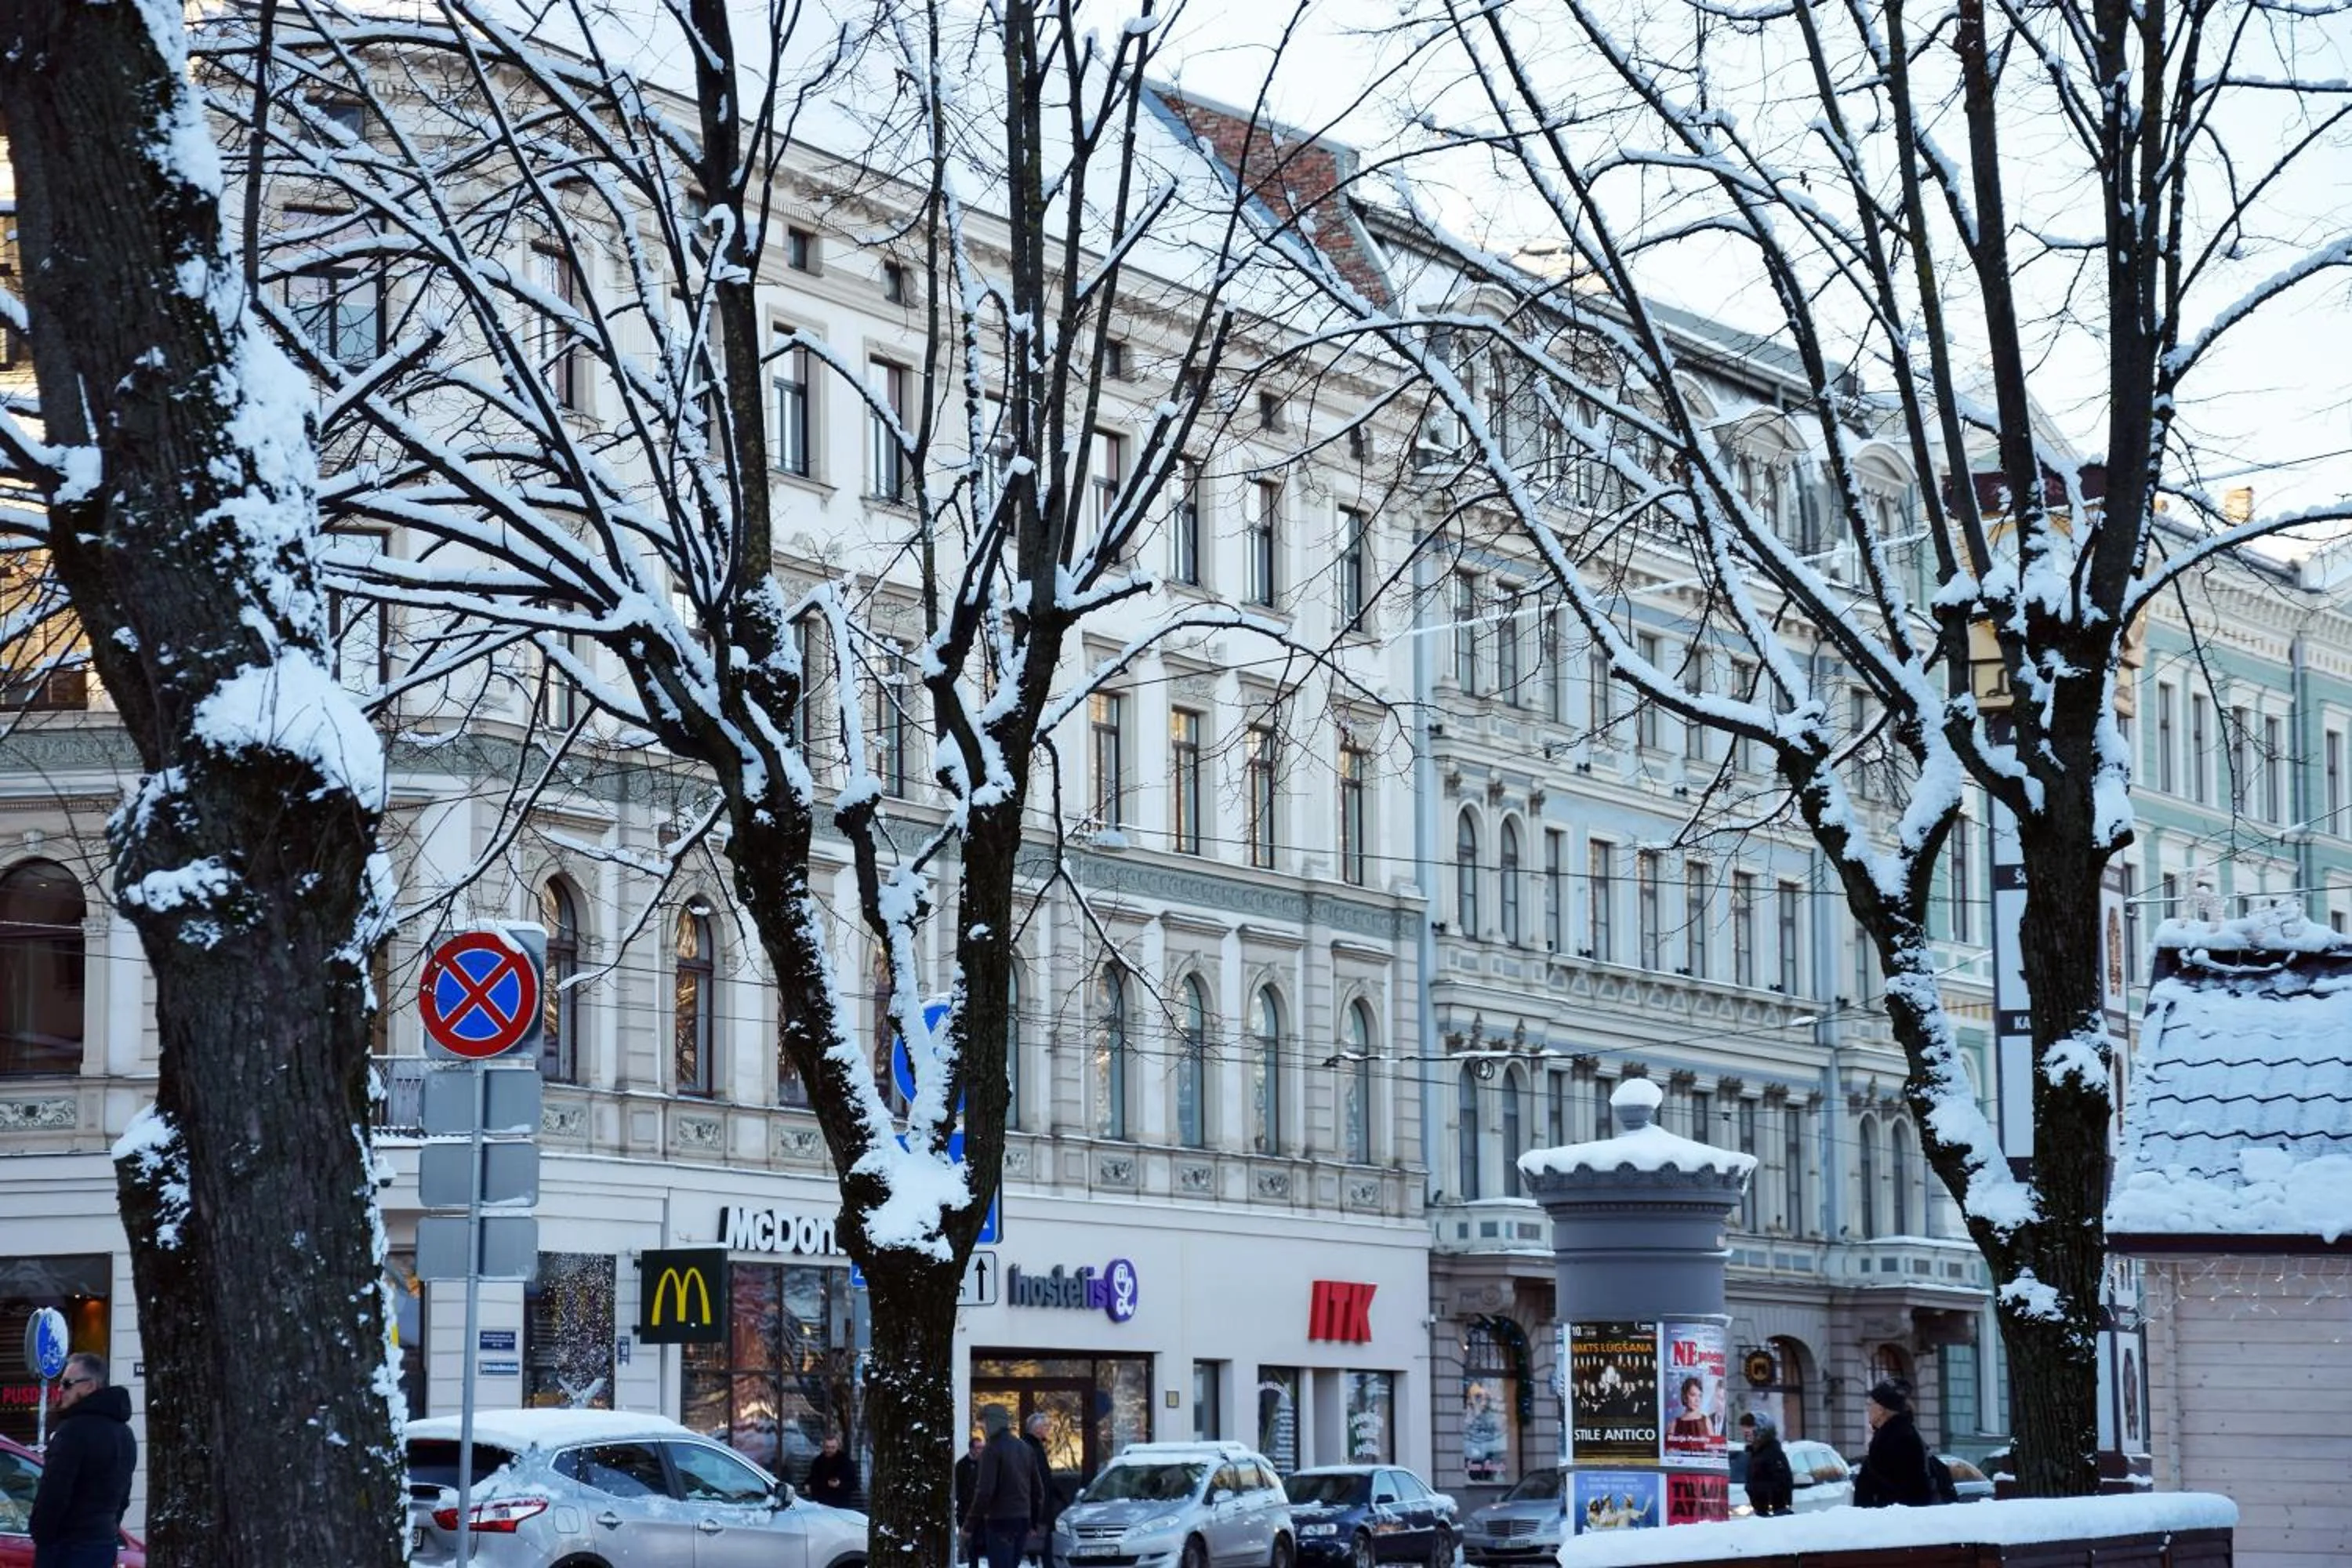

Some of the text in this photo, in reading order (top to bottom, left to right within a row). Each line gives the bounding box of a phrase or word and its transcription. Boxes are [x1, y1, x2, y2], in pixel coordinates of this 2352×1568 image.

[727, 1207, 846, 1254] McDon
[1308, 1280, 1378, 1342] ITK
[1574, 1428, 1656, 1441] STILE ANTICO
